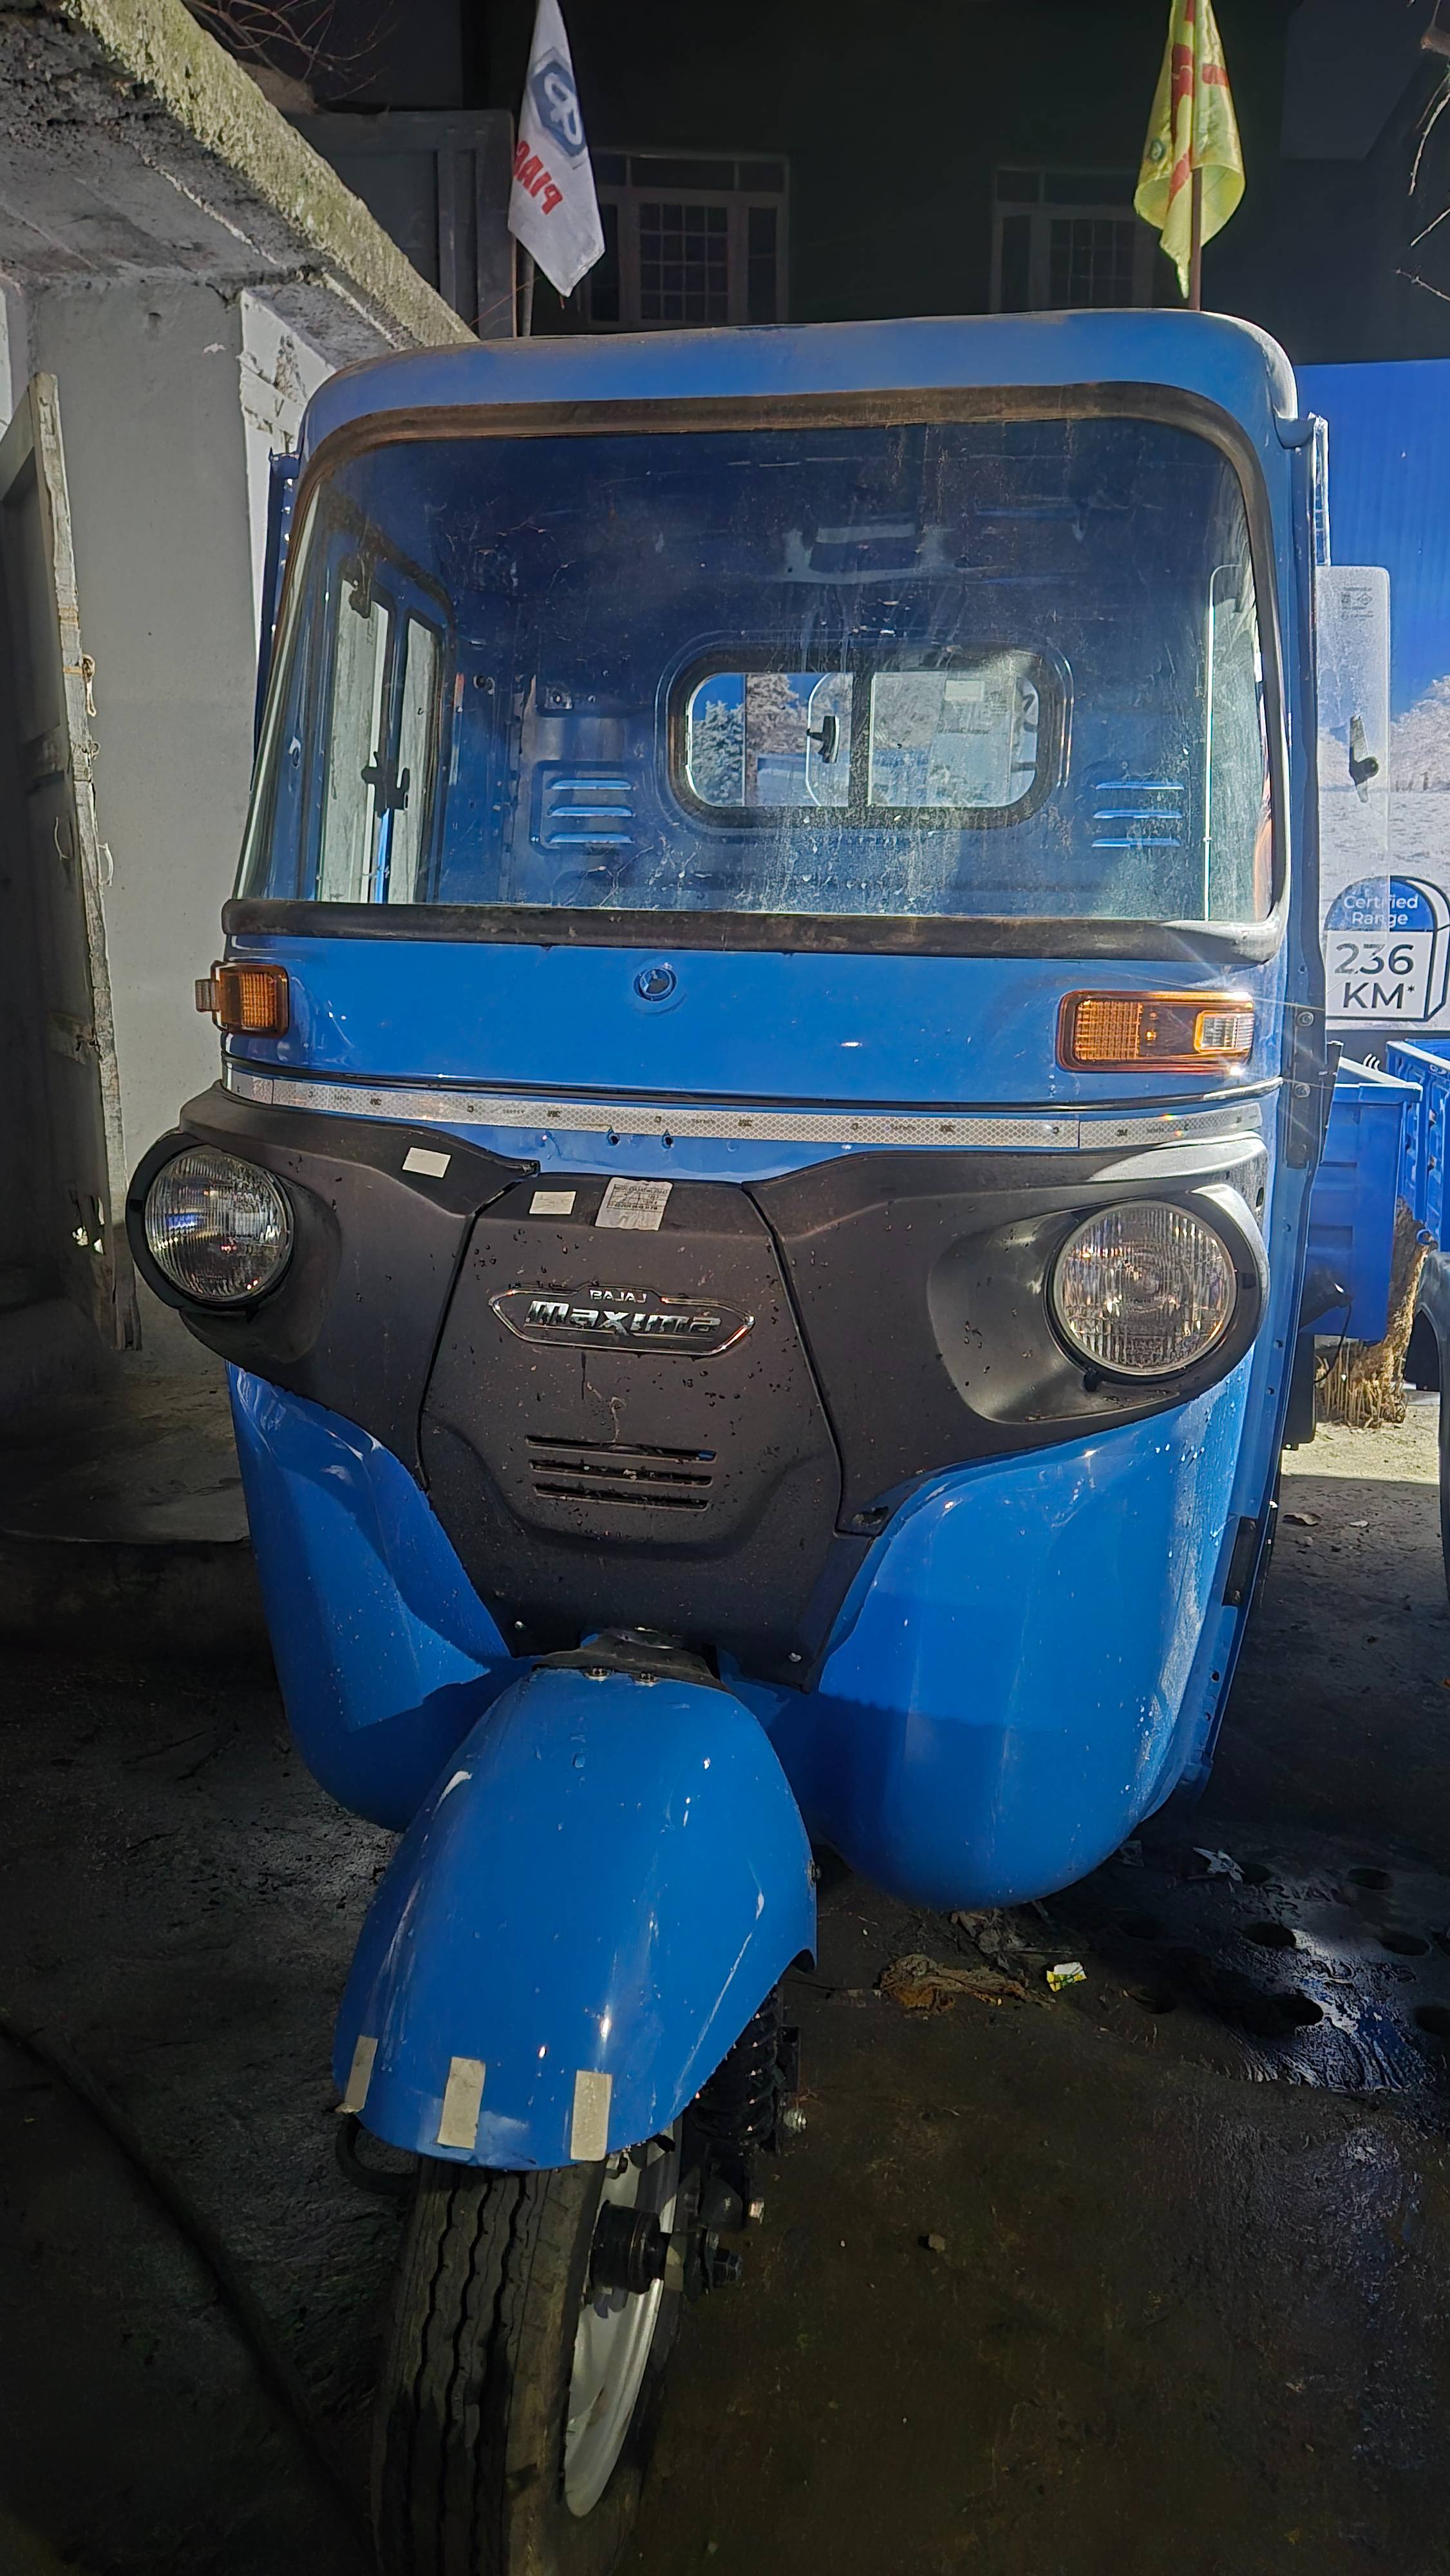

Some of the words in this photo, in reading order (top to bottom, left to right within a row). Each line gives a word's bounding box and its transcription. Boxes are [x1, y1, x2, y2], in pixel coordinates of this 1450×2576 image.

[1352, 911, 1409, 928] Range
[1335, 943, 1415, 975] 236
[589, 1289, 647, 1303] BAJAJ
